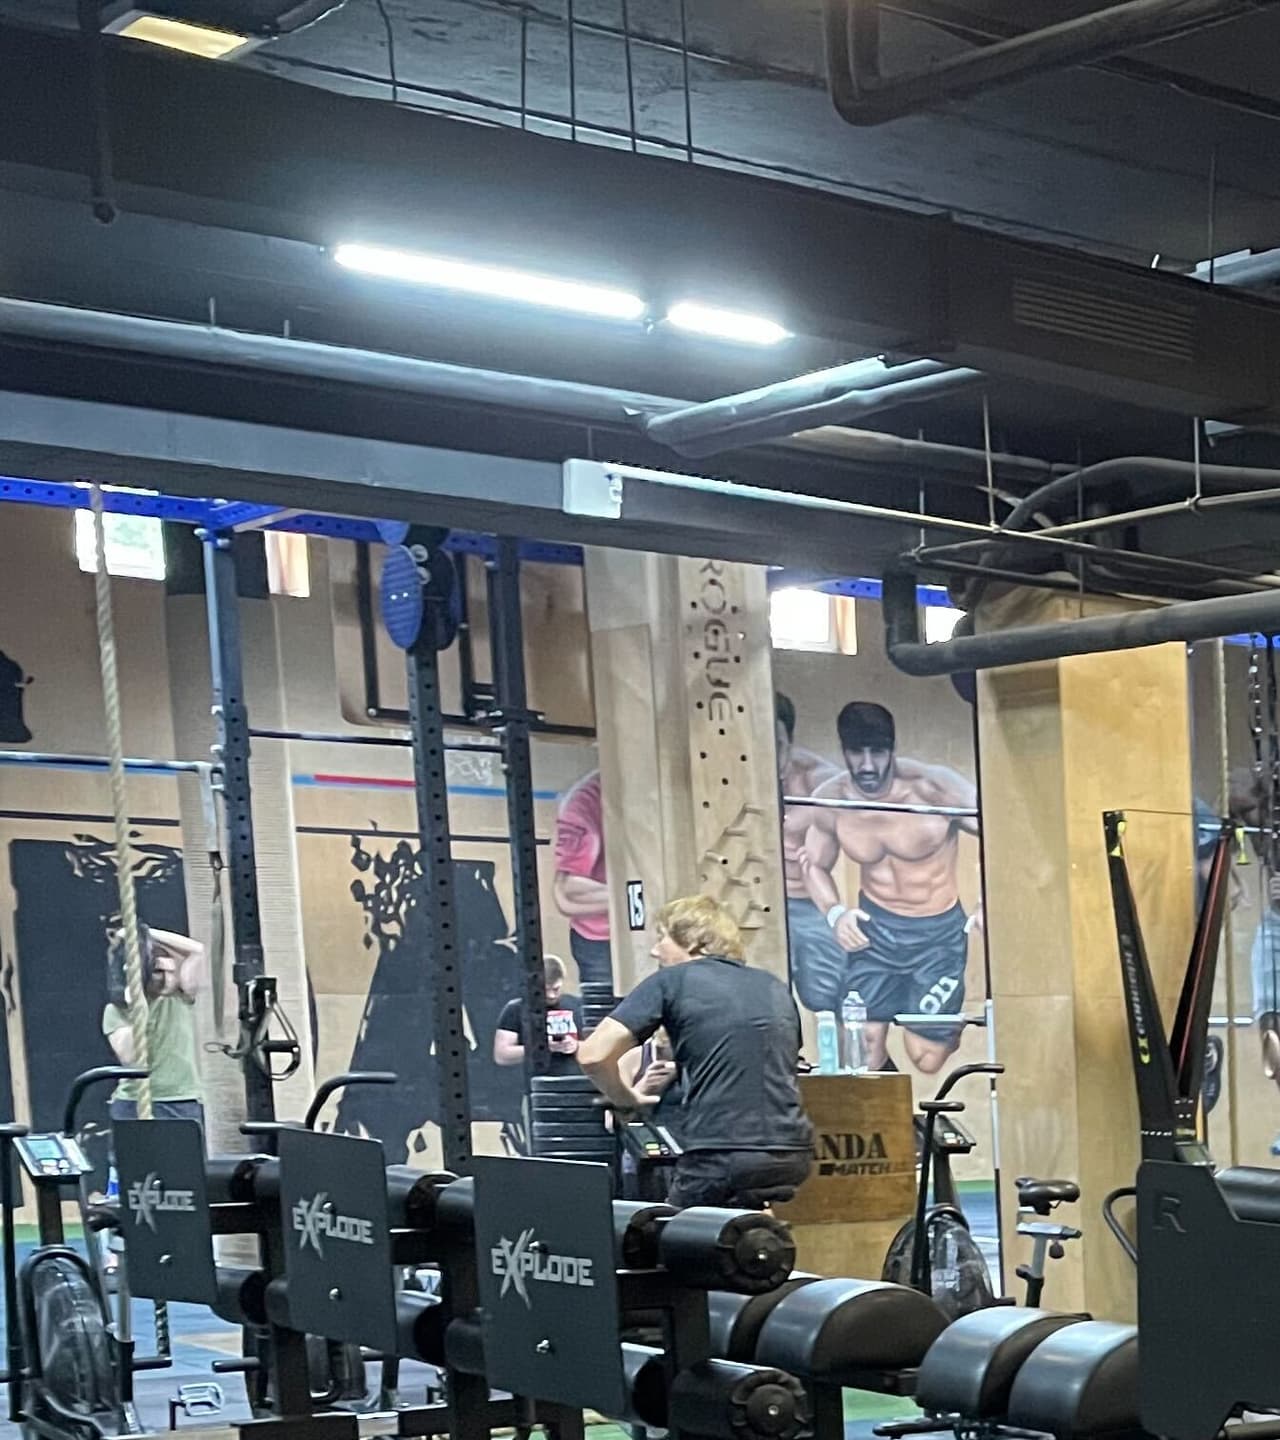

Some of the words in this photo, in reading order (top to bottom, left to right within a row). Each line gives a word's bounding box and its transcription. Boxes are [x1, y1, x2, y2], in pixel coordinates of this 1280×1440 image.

[814, 1132, 888, 1160] NDA
[292, 1192, 375, 1260] EXPLODE
[491, 1227, 595, 1310] EXPLODE
